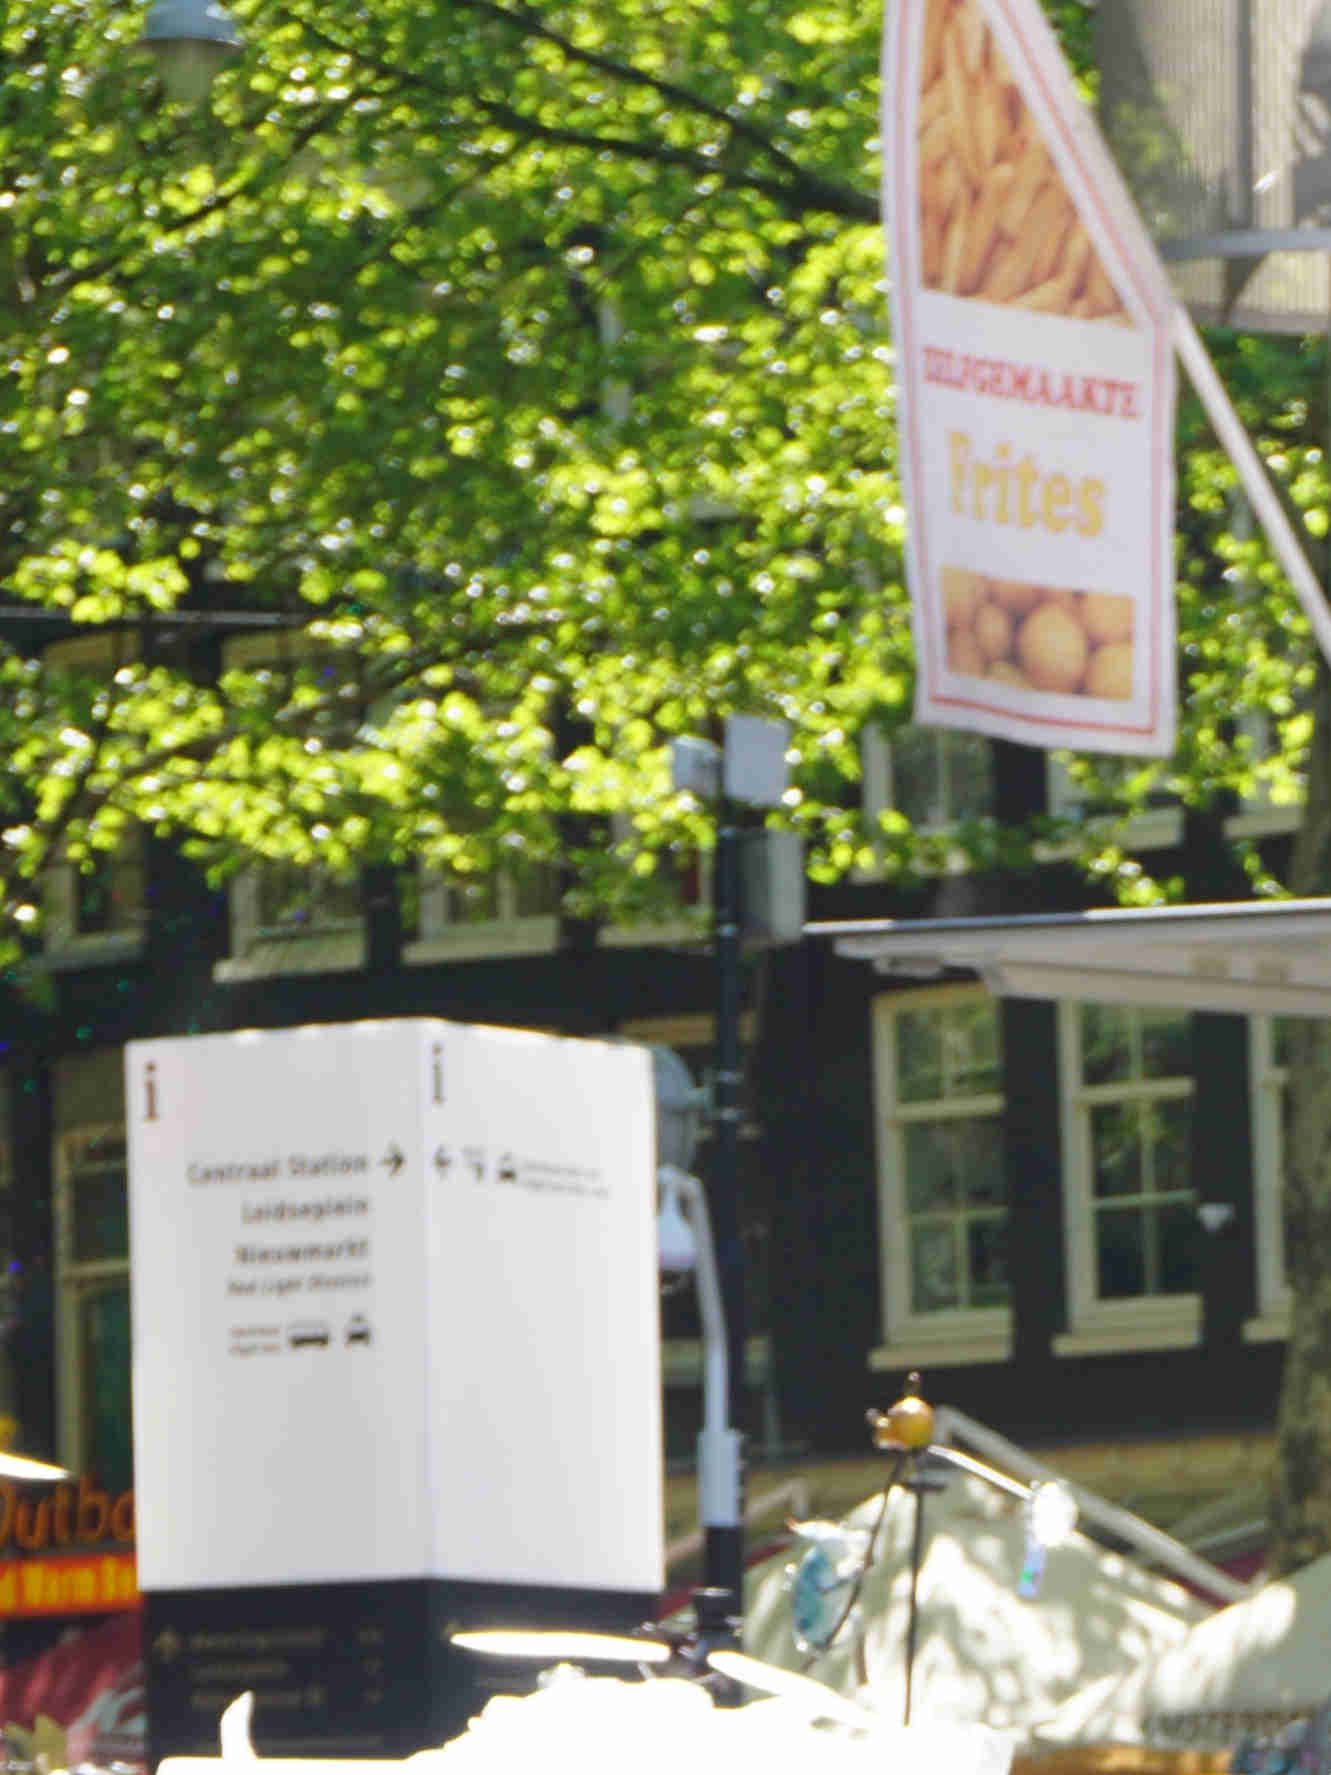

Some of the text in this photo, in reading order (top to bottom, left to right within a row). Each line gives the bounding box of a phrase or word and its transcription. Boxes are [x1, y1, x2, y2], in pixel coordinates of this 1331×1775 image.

[948, 430, 1107, 537] Frites
[186, 1154, 368, 1185] Centraal Station
[241, 1197, 369, 1225] Leidseplein
[234, 1238, 369, 1264] Nieuwmarkt
